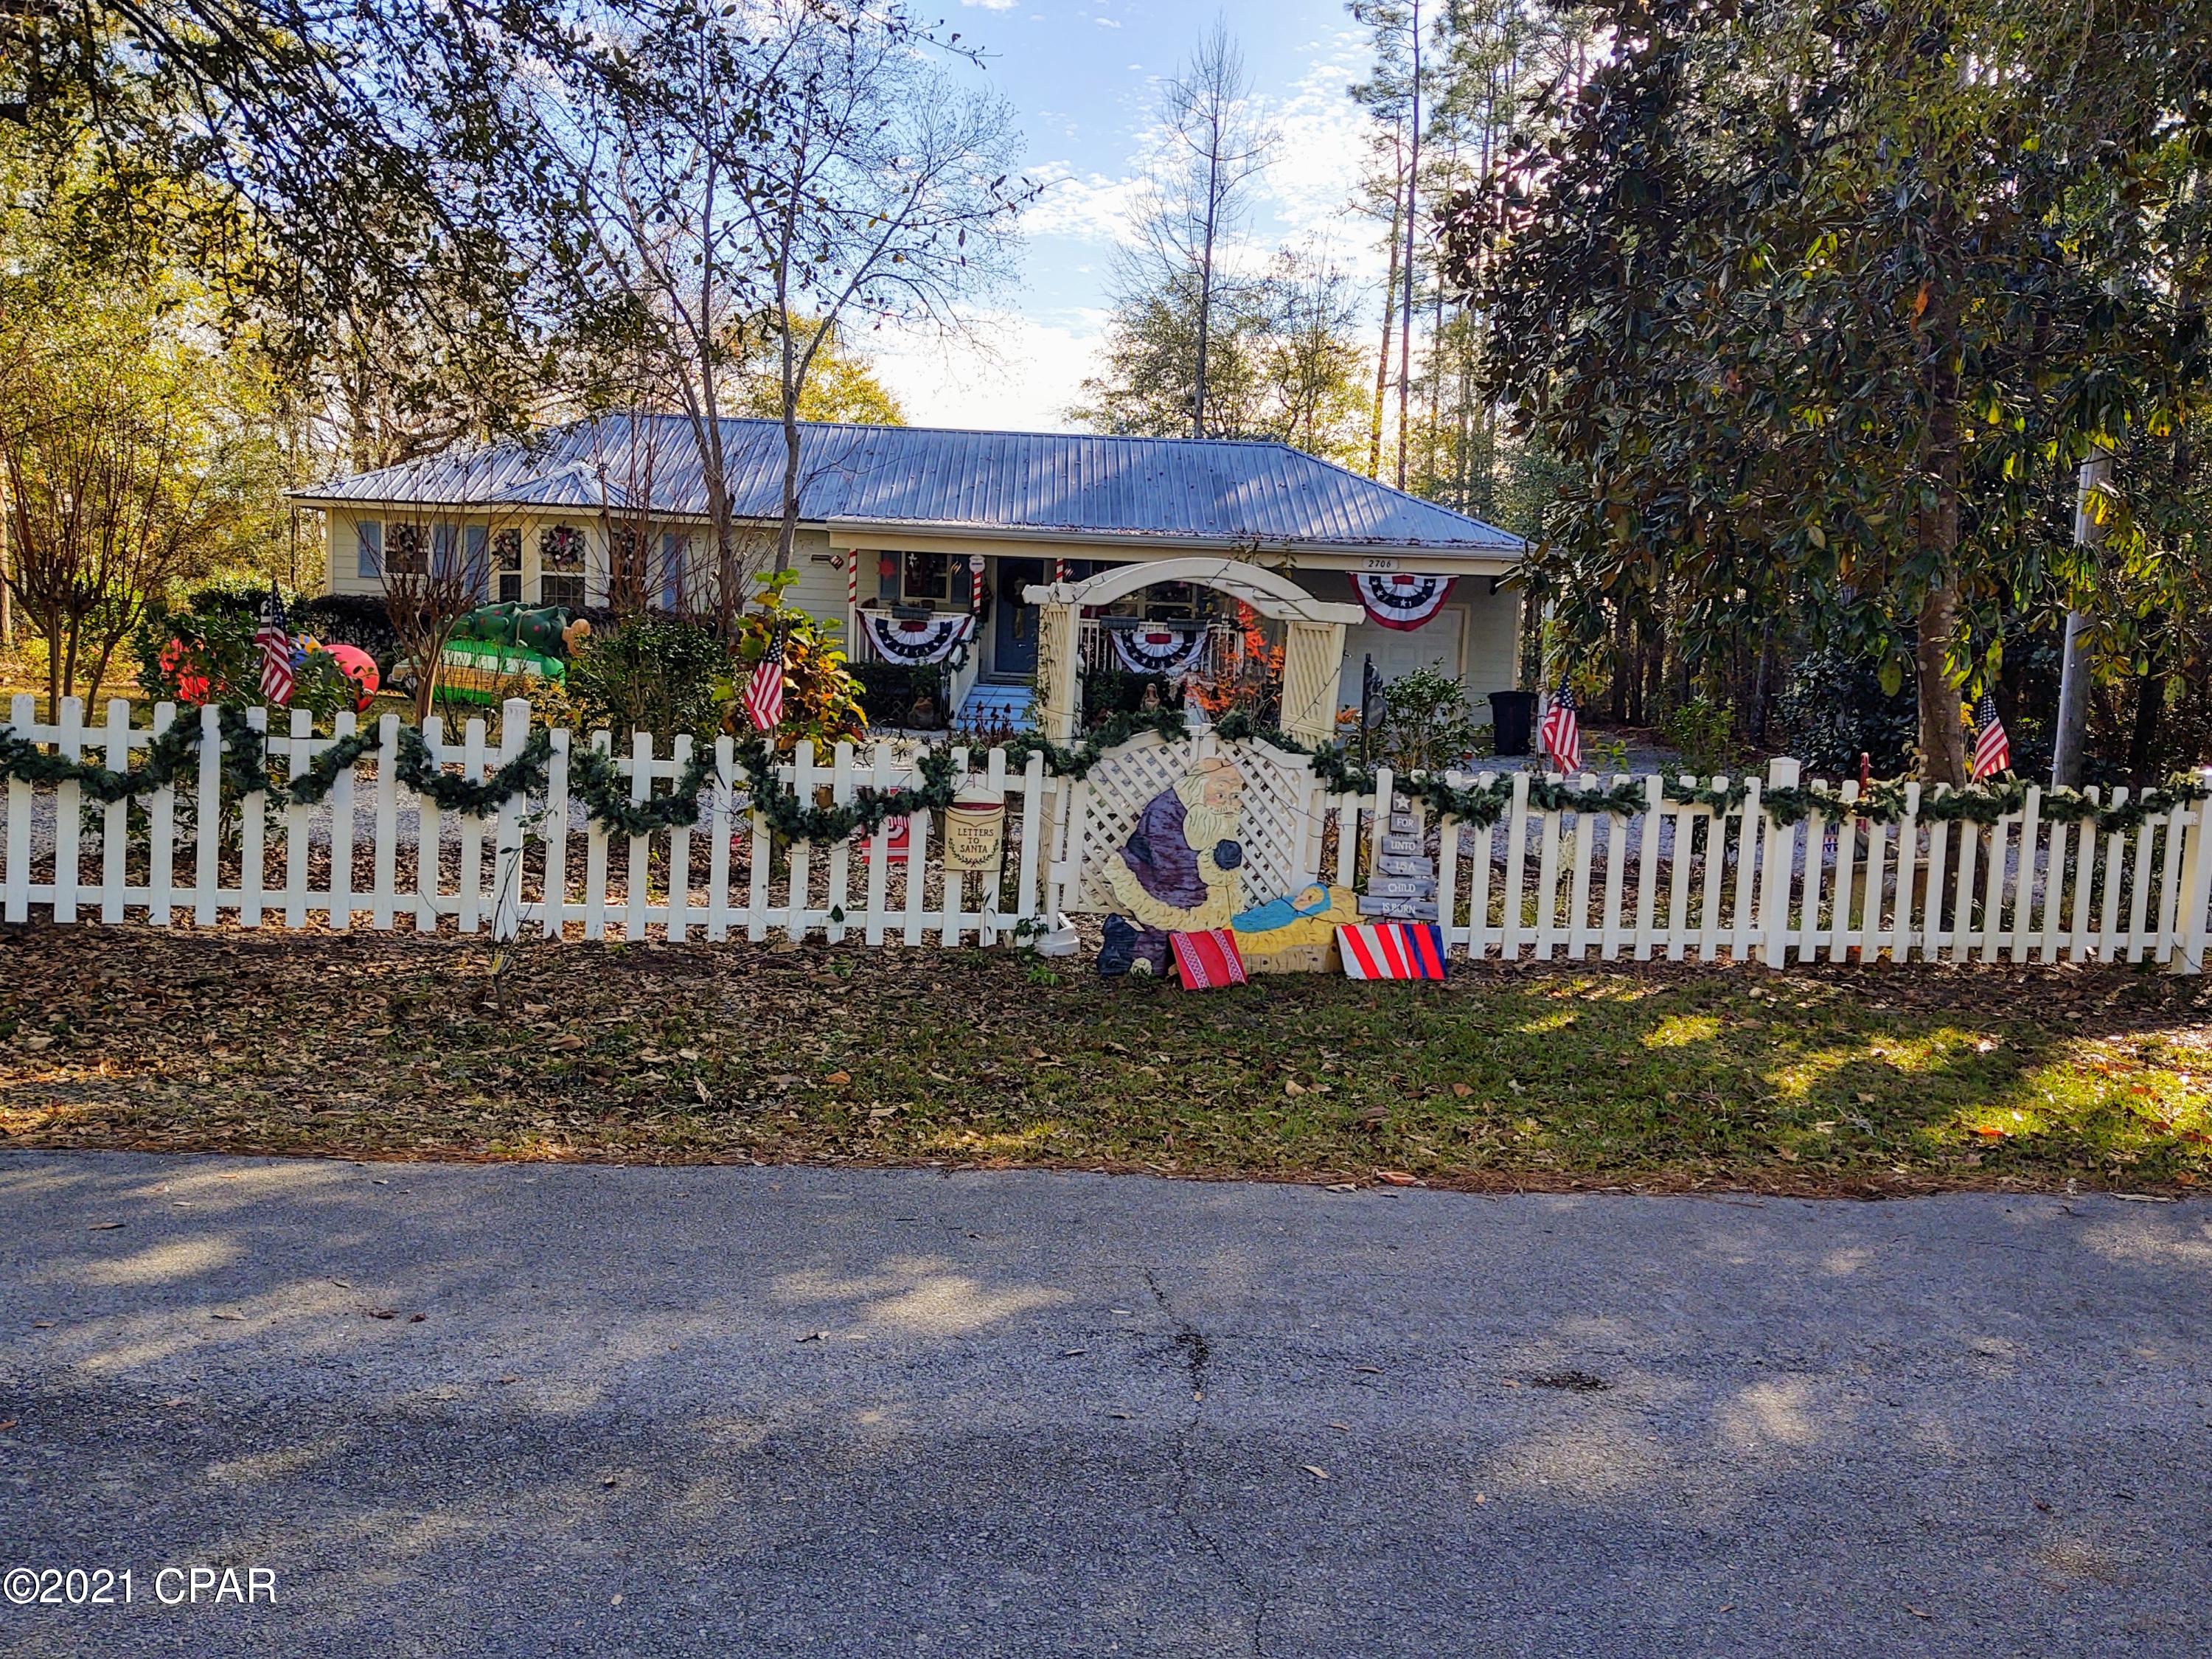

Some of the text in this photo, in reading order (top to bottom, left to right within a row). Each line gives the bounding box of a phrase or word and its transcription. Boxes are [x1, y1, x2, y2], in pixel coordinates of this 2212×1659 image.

[1368, 560, 1391, 568] 2706
[1397, 818, 1415, 828] FOR
[958, 828, 994, 837] LETTERS
[960, 844, 988, 853] SANTA
[1391, 841, 1416, 851] UNTO
[1388, 883, 1416, 893] CHILD
[1382, 902, 1391, 911] IS
